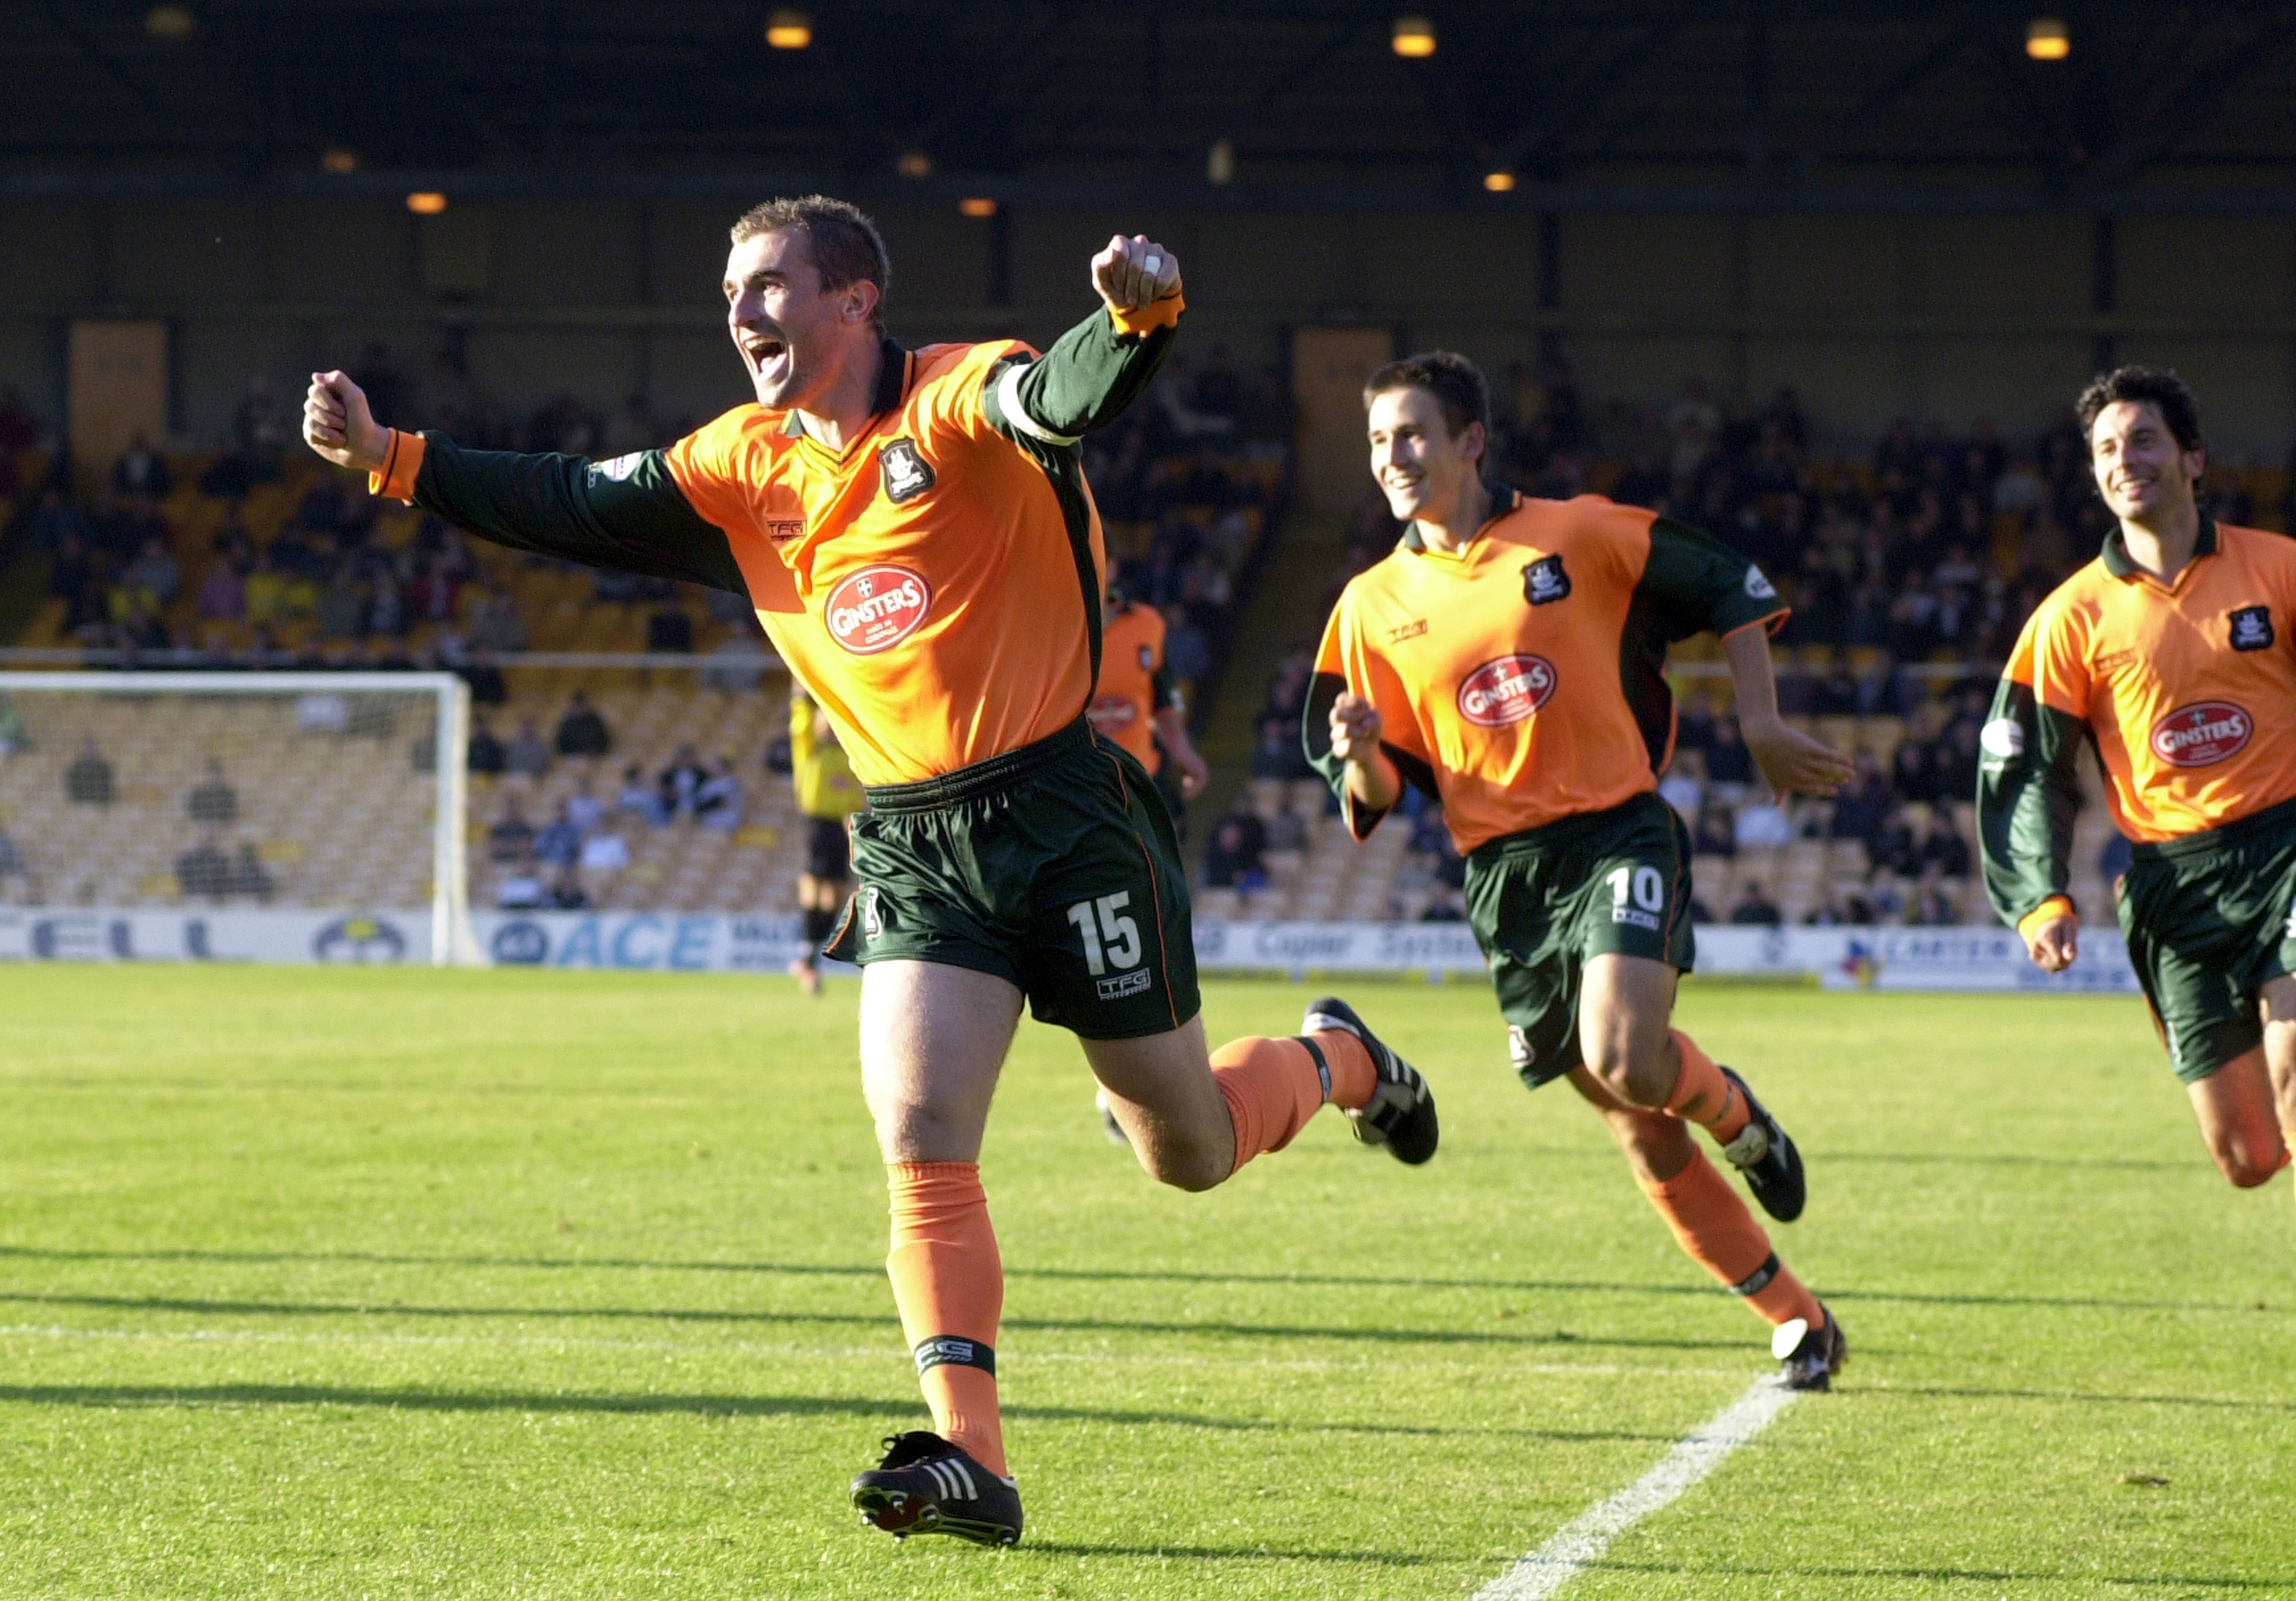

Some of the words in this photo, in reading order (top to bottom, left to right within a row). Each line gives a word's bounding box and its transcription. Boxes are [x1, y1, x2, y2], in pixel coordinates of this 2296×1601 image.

[832, 579, 921, 637] GINSTERS
[1465, 665, 1549, 714] GINSTERS
[2158, 714, 2245, 753] GINSTERS
[1606, 866, 1663, 912] 10
[557, 915, 720, 969] ACE
[1066, 890, 1142, 976] 15
[1100, 972, 1148, 993] TFG
